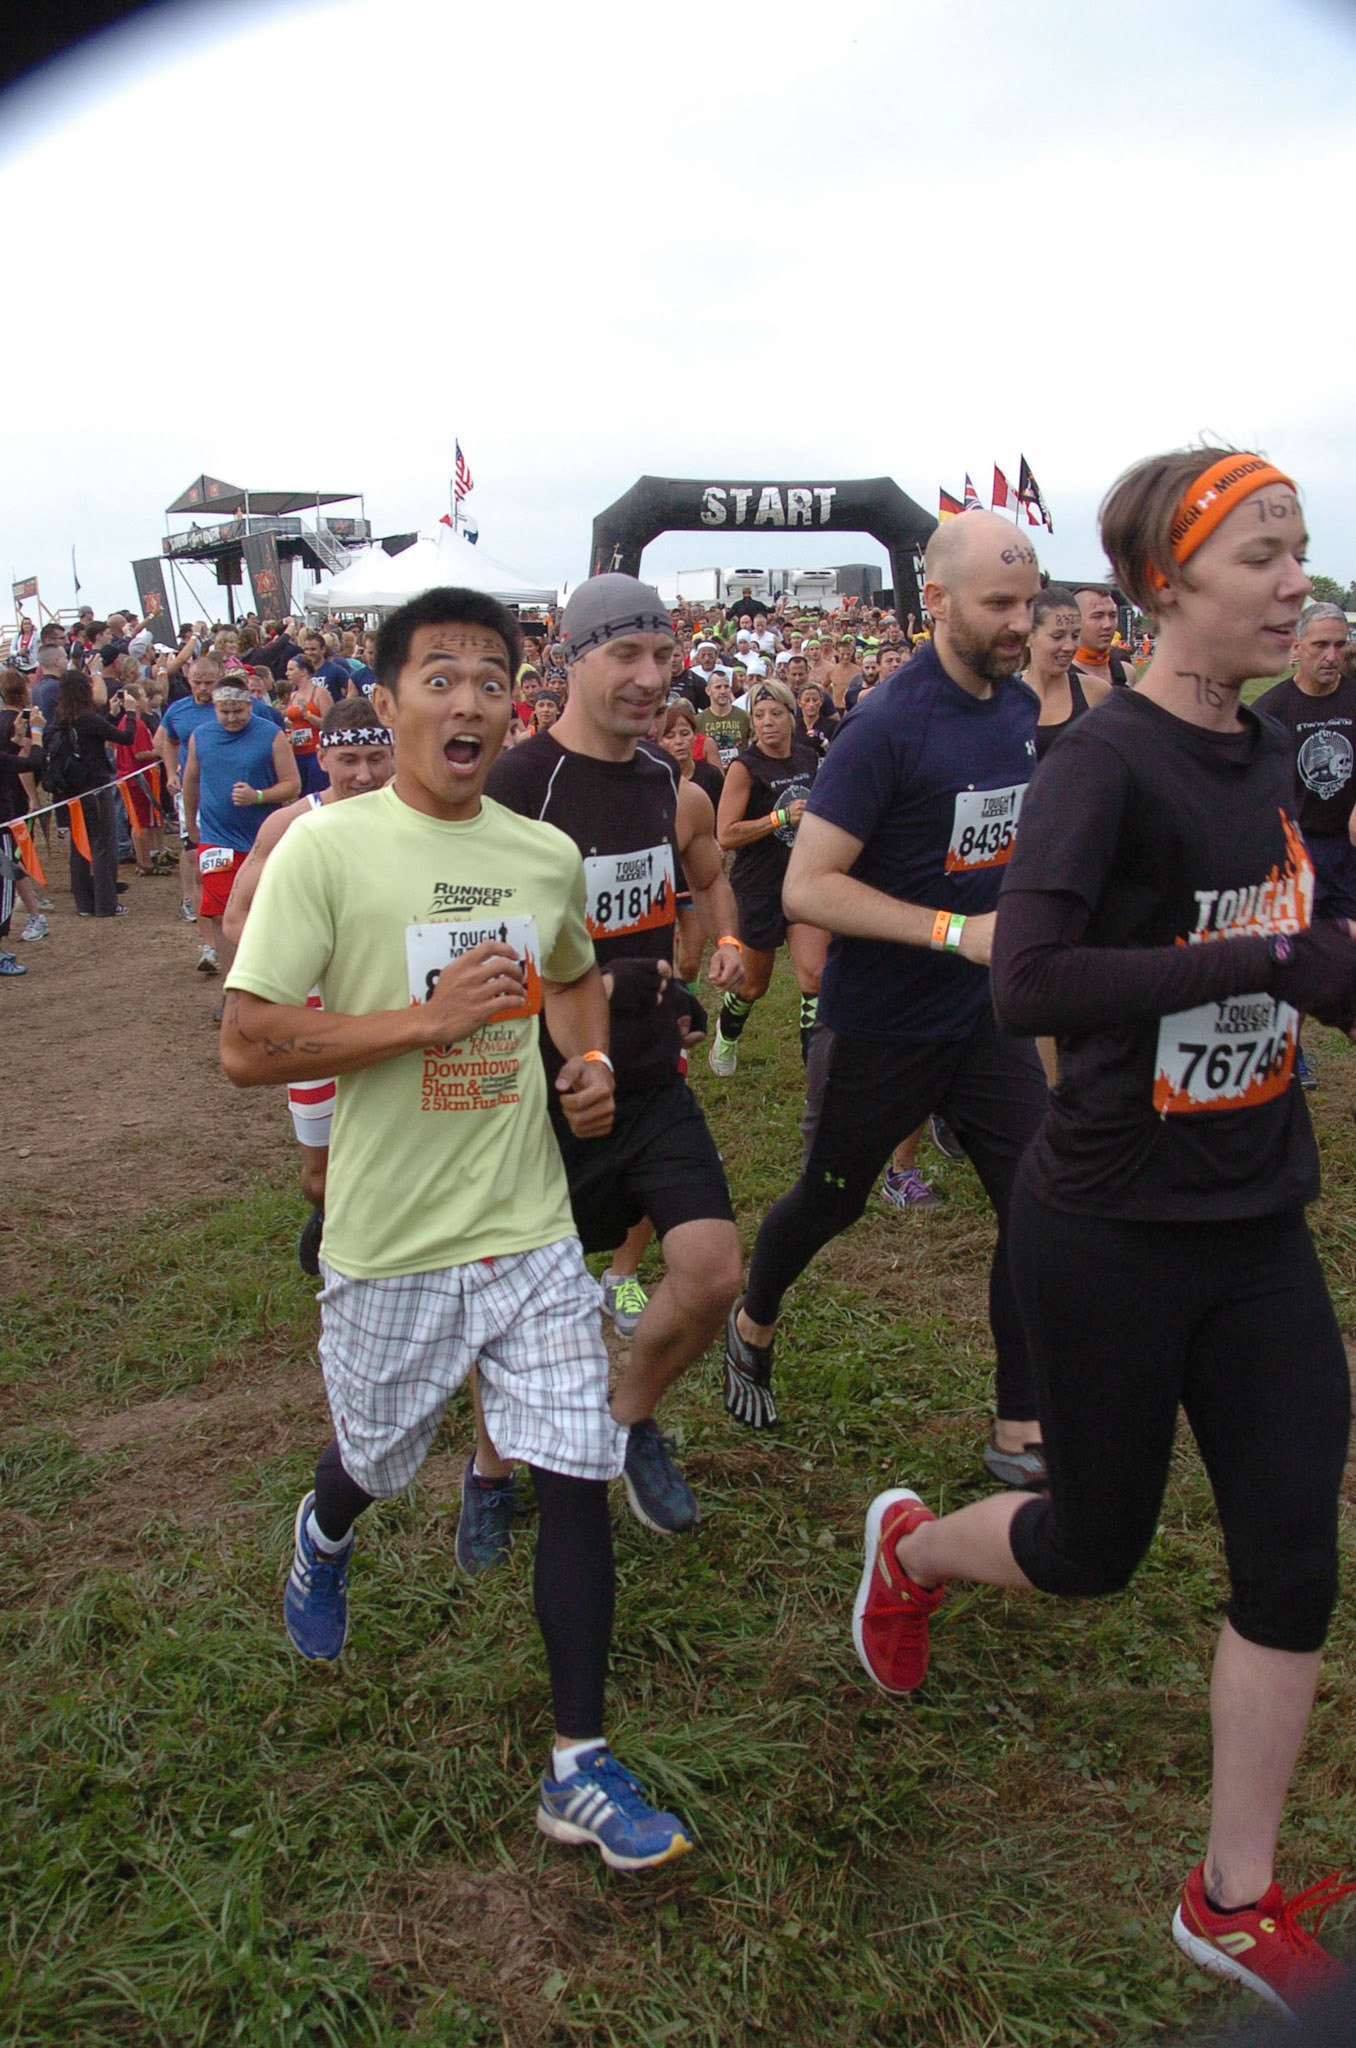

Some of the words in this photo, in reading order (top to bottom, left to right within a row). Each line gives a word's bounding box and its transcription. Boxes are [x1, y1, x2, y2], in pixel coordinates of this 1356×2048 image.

[701, 486, 837, 526] START
[959, 820, 1018, 857] 8435
[616, 859, 647, 875] TOUGH
[443, 895, 500, 907] CHOICE
[596, 880, 666, 924] 81814
[1194, 878, 1295, 932] TOUGH
[1219, 1003, 1270, 1022] TOUGH
[423, 1058, 520, 1078] Downtown
[1178, 1032, 1287, 1090] 76746
